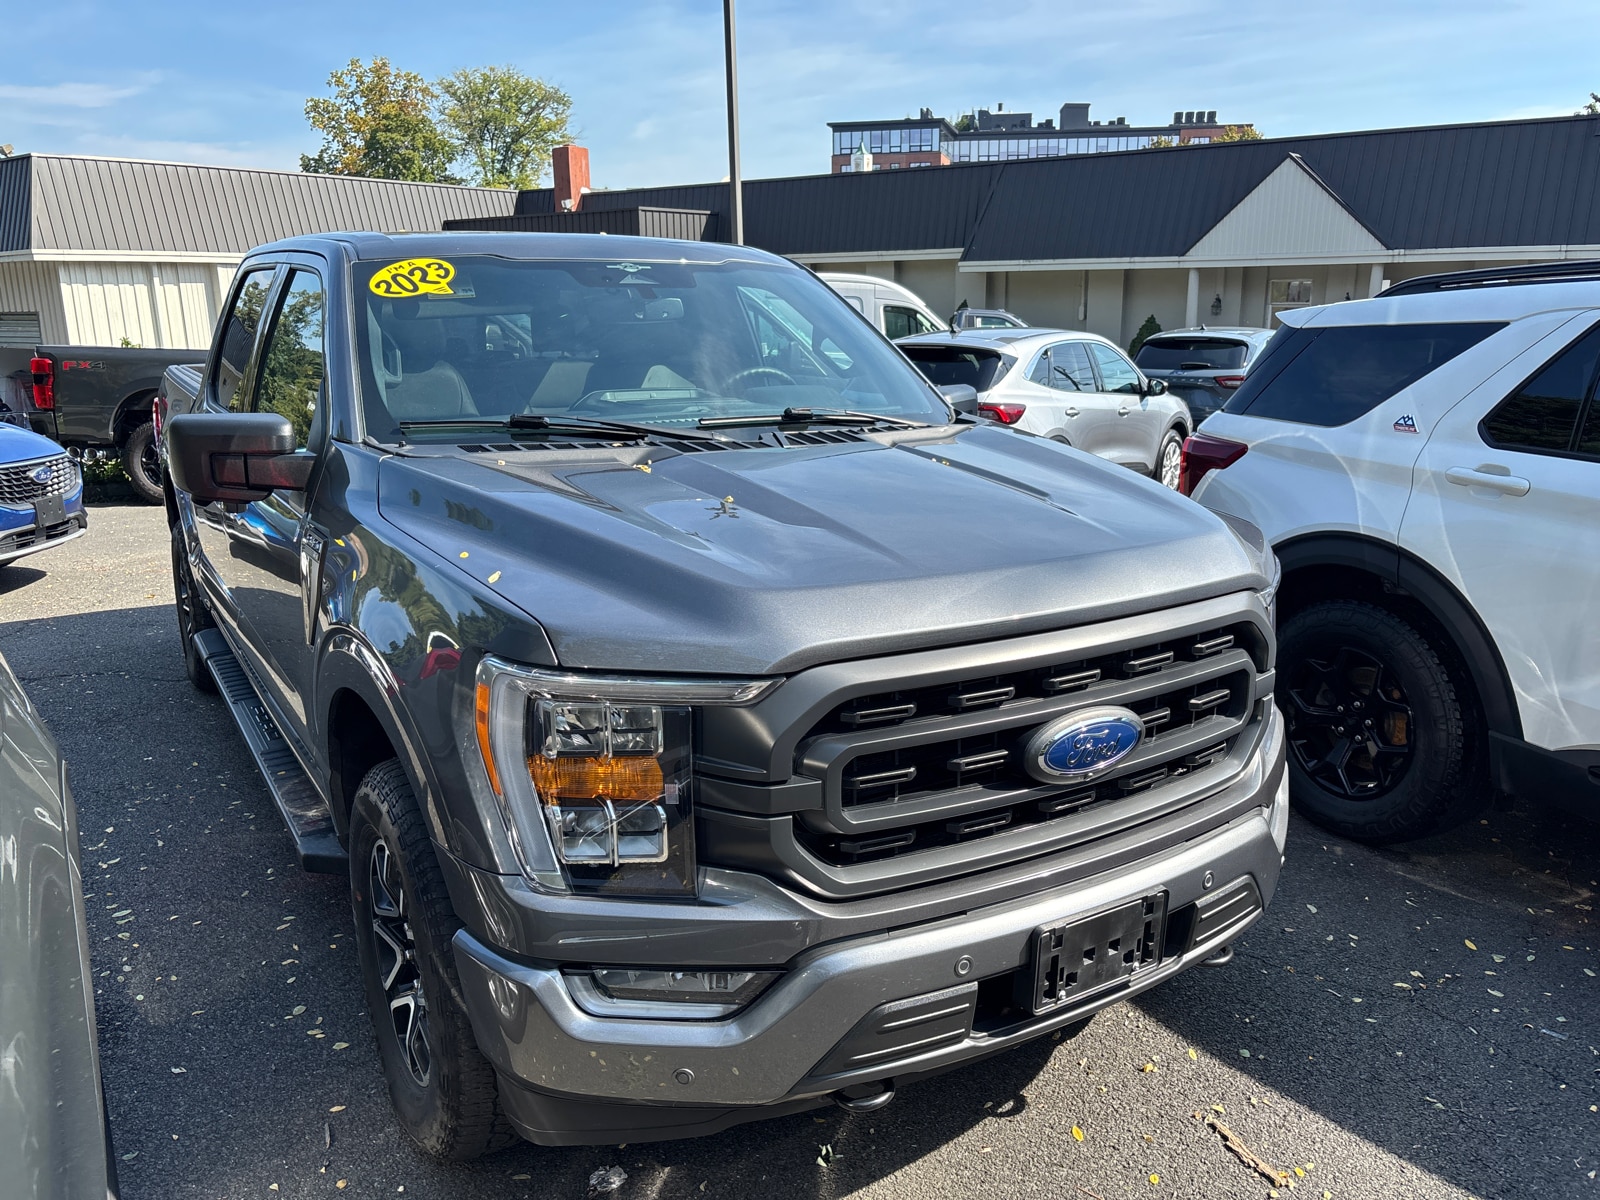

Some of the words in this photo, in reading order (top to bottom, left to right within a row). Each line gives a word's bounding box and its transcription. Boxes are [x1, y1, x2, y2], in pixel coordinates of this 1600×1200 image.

[375, 262, 450, 295] 2023
[386, 265, 404, 274] I'M
[63, 361, 105, 370] FX4
[1067, 729, 1121, 767] Ford
